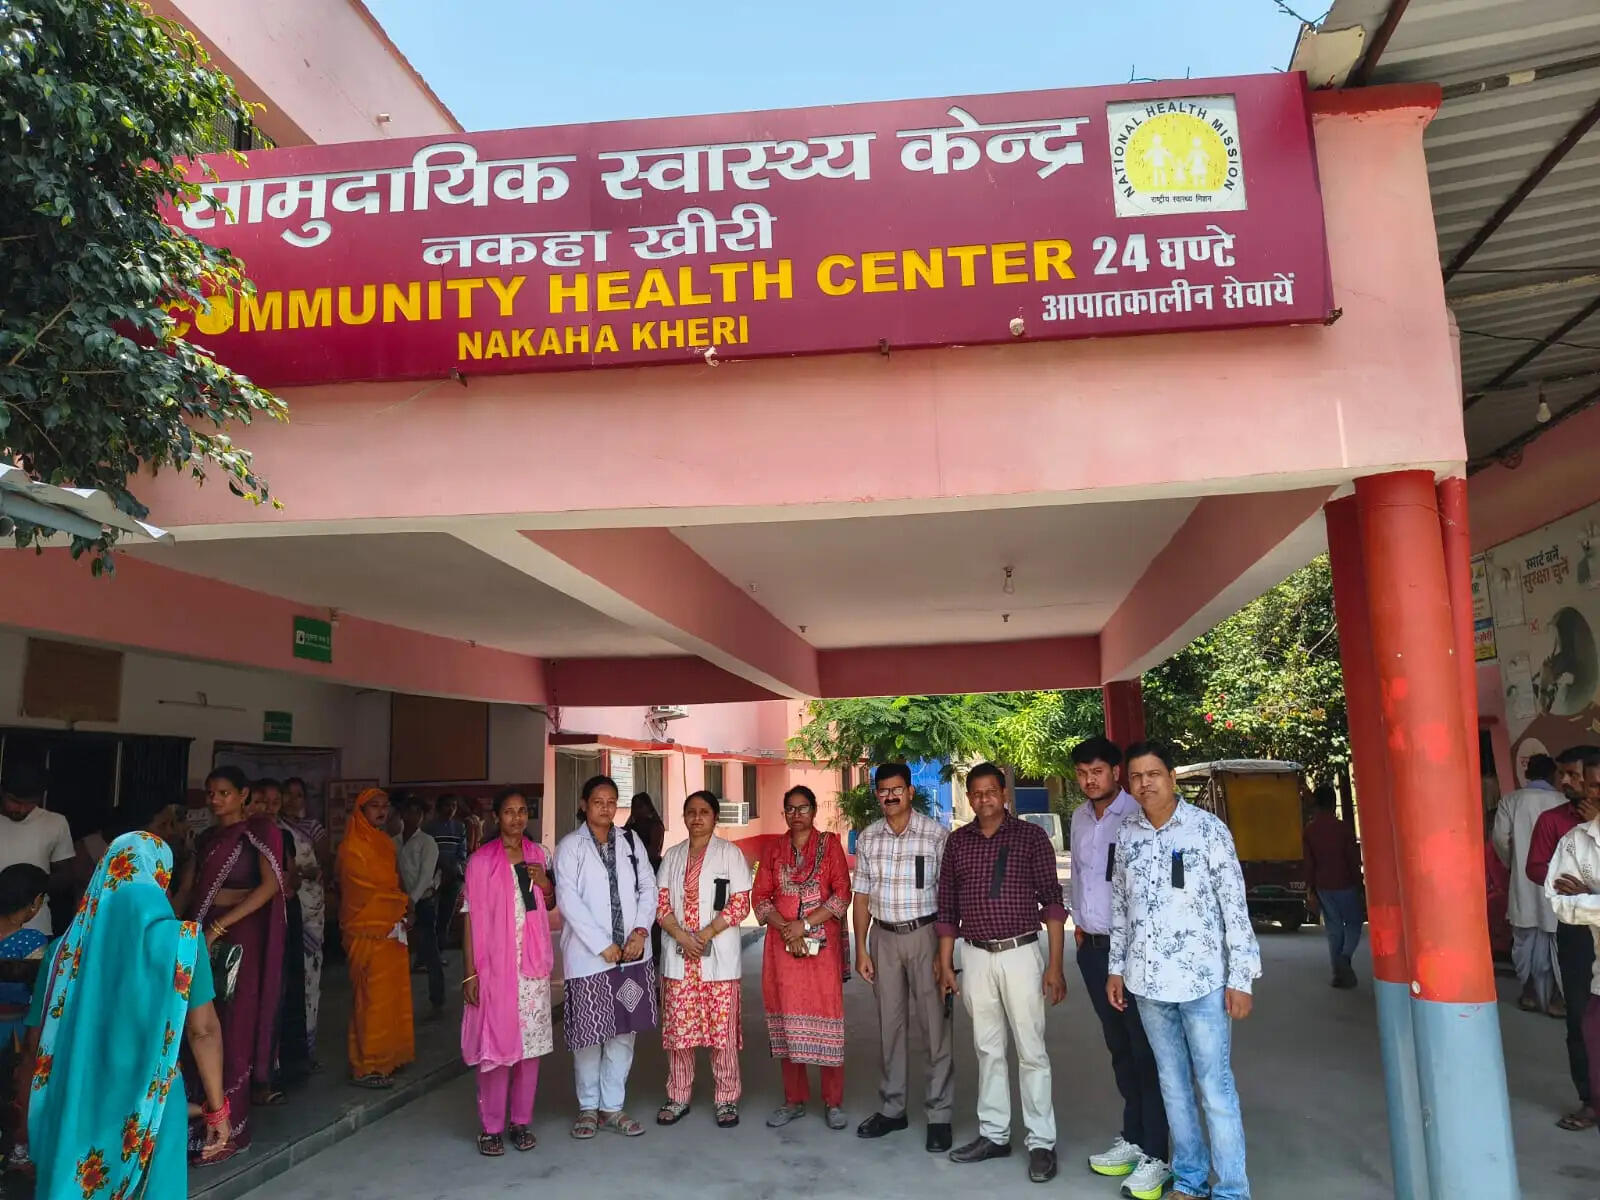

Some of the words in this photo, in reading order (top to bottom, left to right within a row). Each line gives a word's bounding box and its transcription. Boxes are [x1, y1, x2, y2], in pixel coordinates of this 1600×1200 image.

[178, 142, 577, 248] सामुदायिक
[598, 132, 878, 201] स्वास्थ्य
[896, 106, 1091, 180] केन्द्र
[1114, 117, 1142, 198] NATIONAL
[1146, 102, 1207, 120] HEALTH
[1211, 119, 1239, 191] MISSION
[421, 230, 613, 268] नकहा
[628, 203, 778, 260] खीरी
[1092, 233, 1151, 276] 24
[1156, 225, 1237, 271] घण्टे
[549, 260, 793, 315] HEALTH
[816, 239, 1076, 296] CENTER
[1042, 278, 1215, 321] आपातकालीन
[1221, 272, 1295, 309] सेवायें
[458, 325, 619, 360] NAKAHA
[632, 316, 749, 350] KHERI
